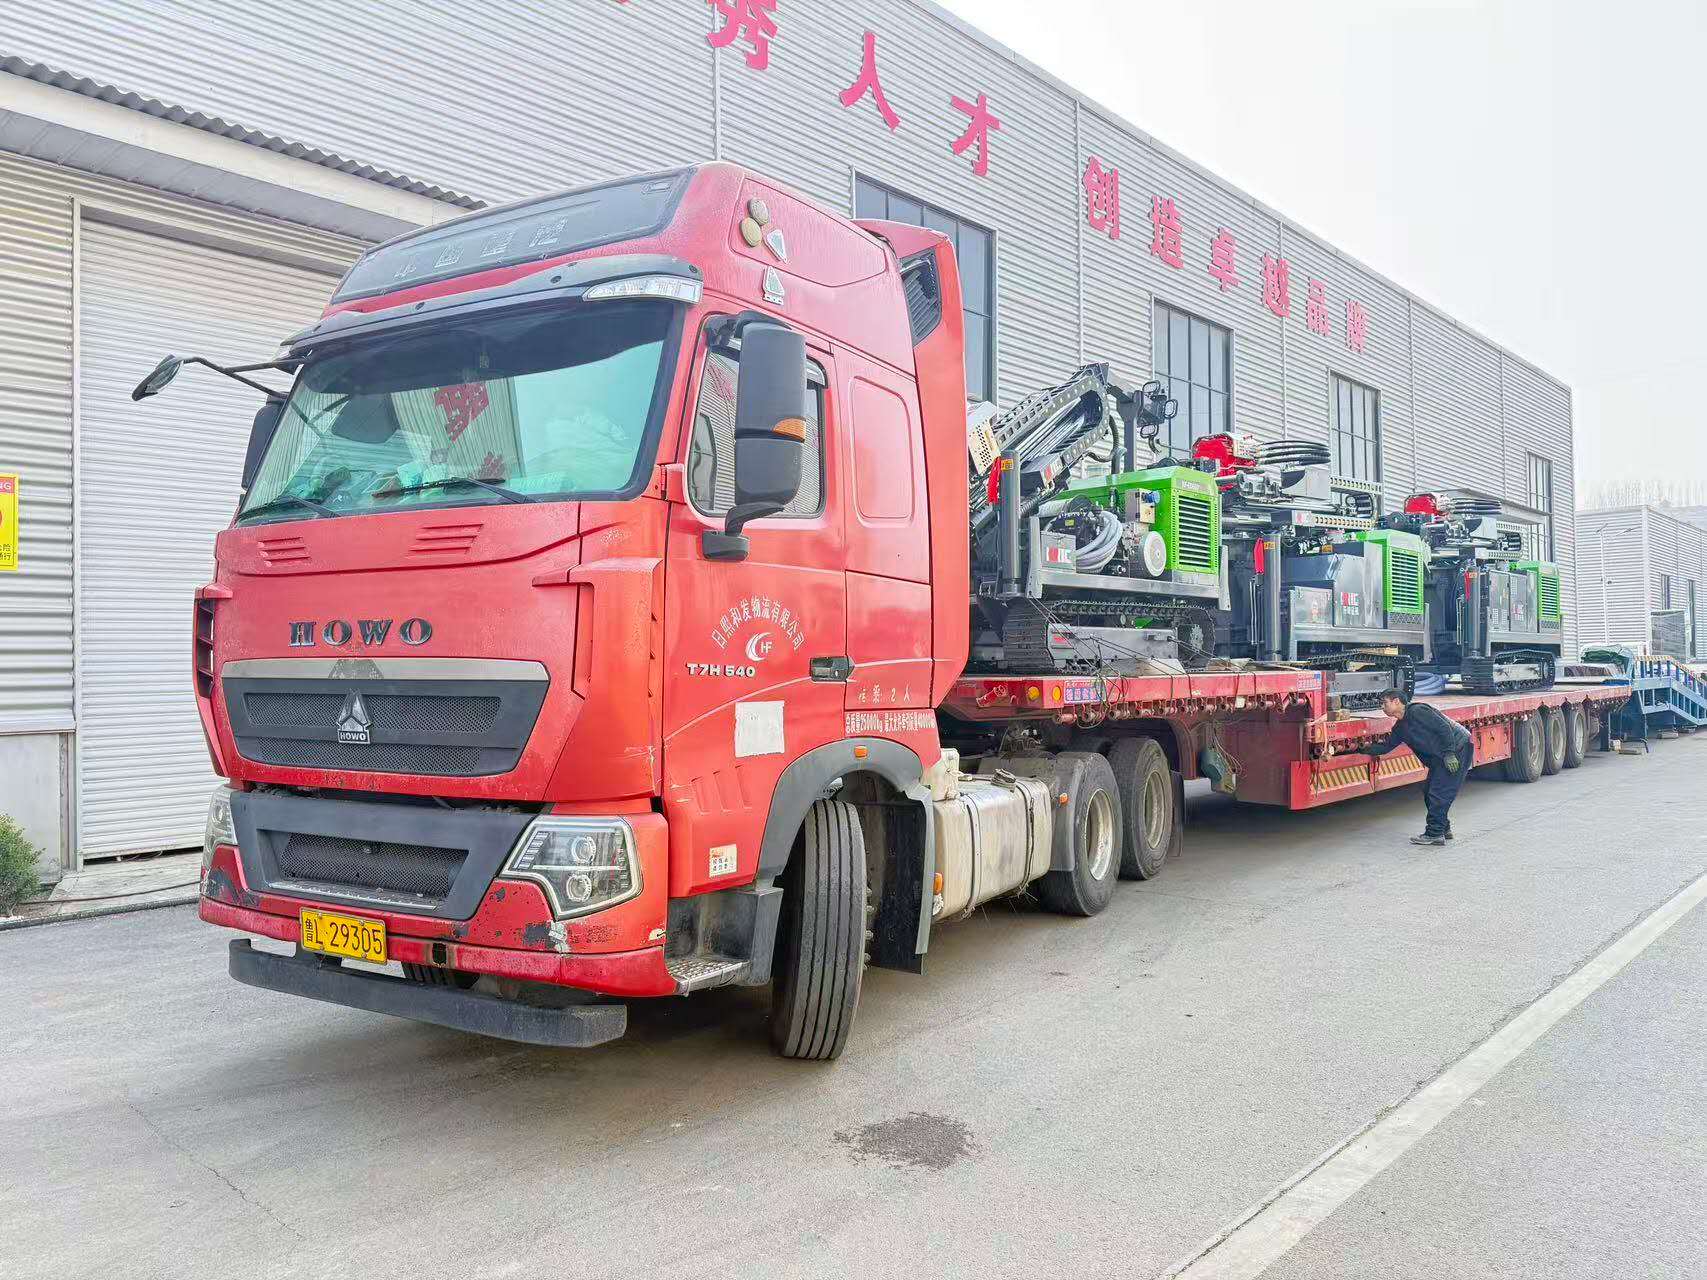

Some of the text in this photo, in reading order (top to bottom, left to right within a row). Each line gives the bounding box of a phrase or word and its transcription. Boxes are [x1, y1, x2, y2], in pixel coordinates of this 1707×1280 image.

[288, 618, 432, 646] HOWO
[686, 662, 756, 678] T7H 540
[339, 732, 367, 742] HOWO
